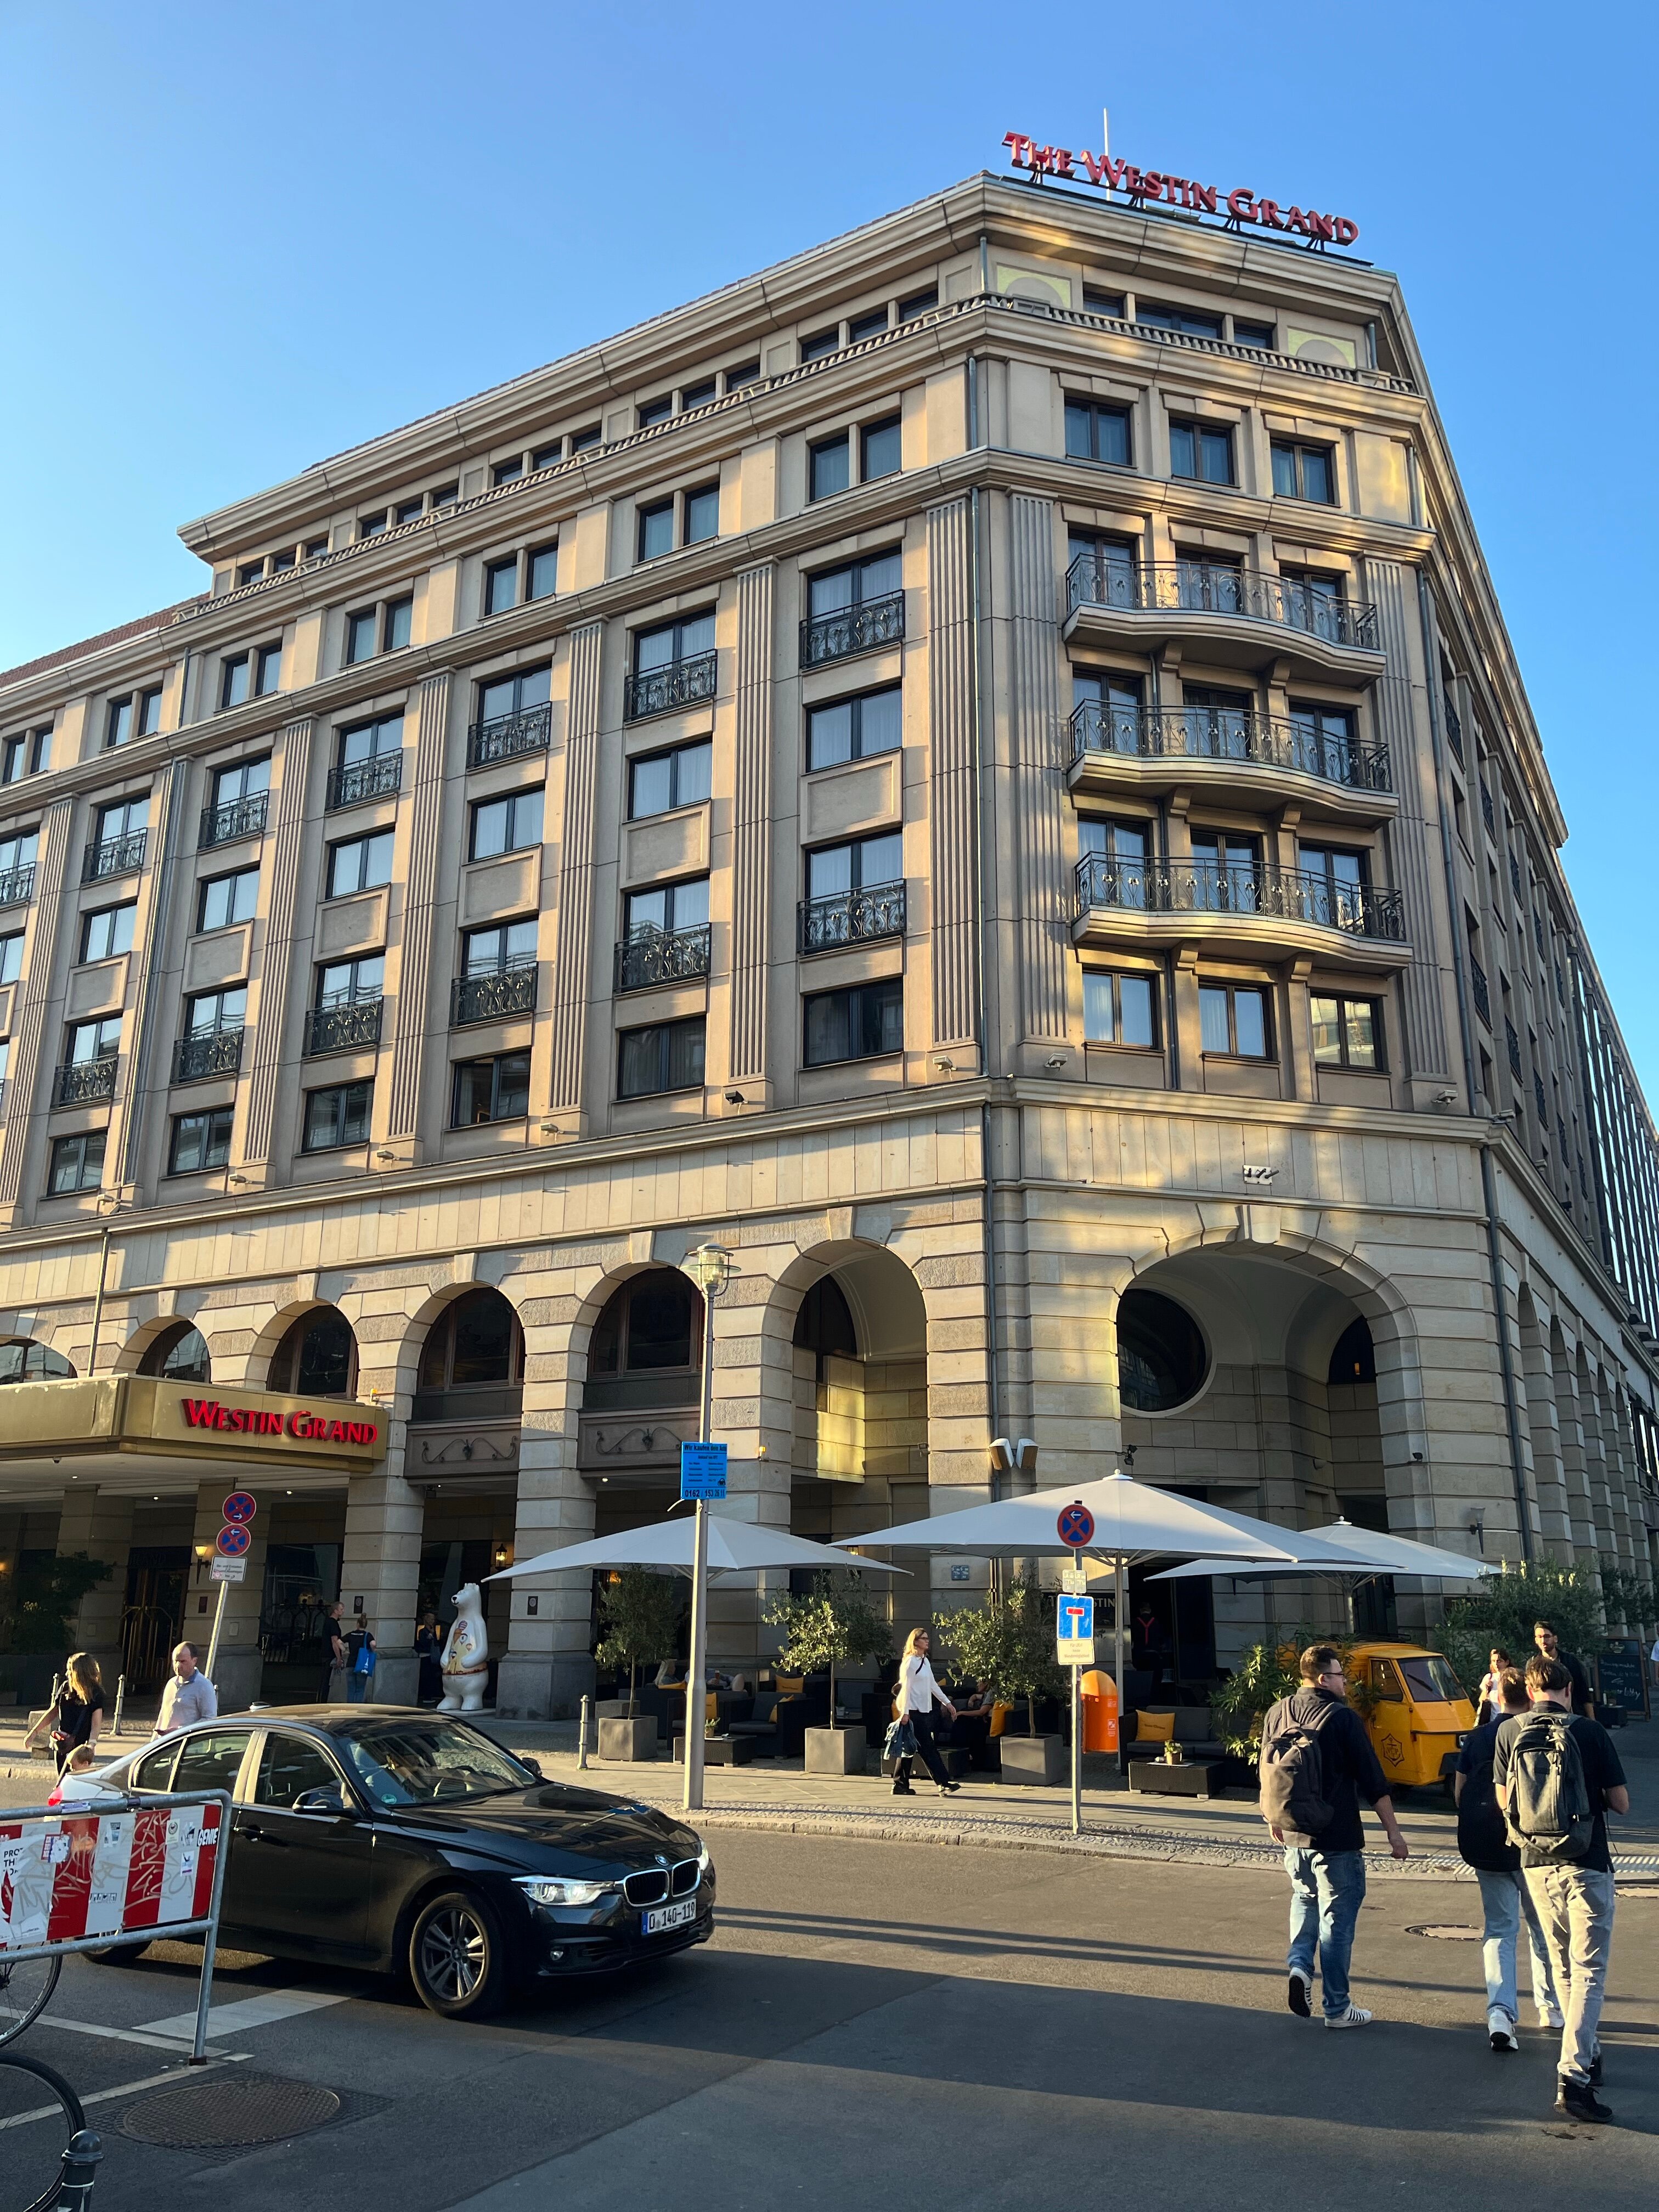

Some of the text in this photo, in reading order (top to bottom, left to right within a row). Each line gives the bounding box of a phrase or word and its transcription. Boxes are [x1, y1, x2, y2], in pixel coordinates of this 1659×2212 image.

[1003, 131, 1359, 246] THE WESTIN GRAND
[181, 1398, 378, 1444] WESTIN GRAND
[685, 1489, 699, 1498] 0162
[705, 1489, 714, 1497] 153
[1093, 1598, 1115, 1607] STIN
[198, 1827, 219, 1847] GENIE
[662, 1901, 695, 1927] 140-119
